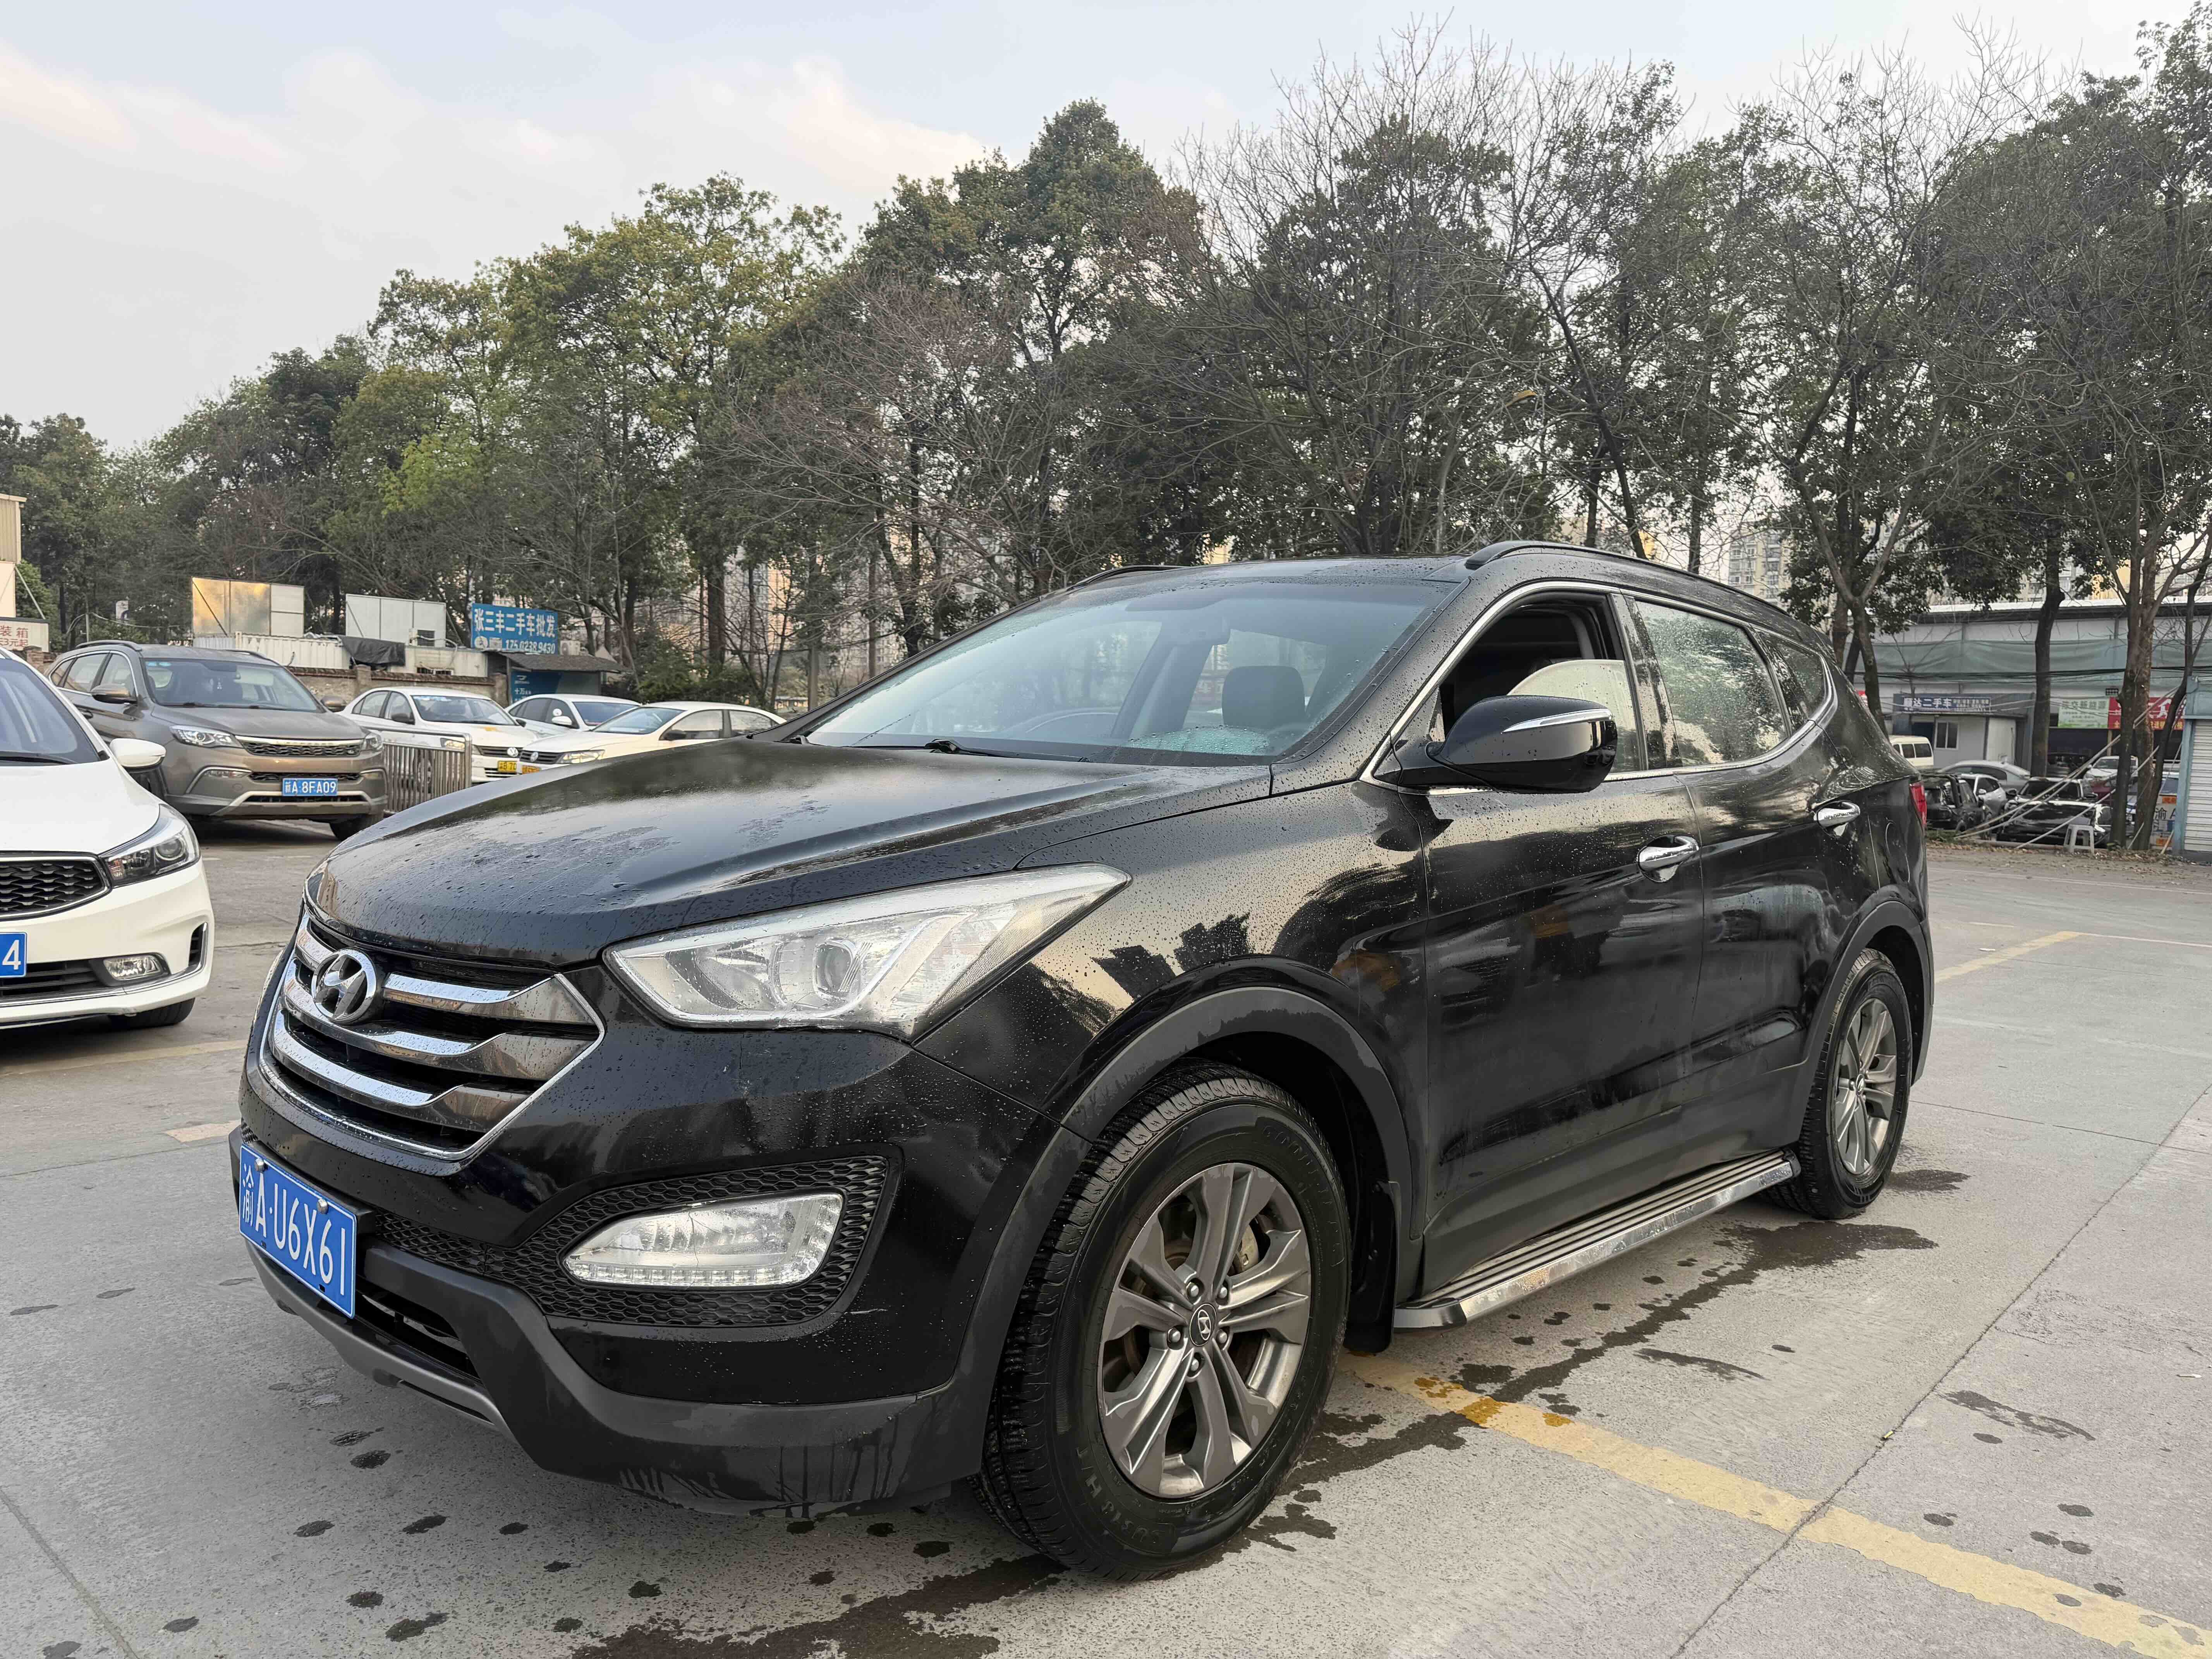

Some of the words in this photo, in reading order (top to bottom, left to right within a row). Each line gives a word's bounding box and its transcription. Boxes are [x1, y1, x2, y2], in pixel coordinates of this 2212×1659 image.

[474, 608, 555, 638] 张三丰二手车批发
[2, 939, 21, 970] 4
[242, 1163, 346, 1296] 渝A·U6X61
